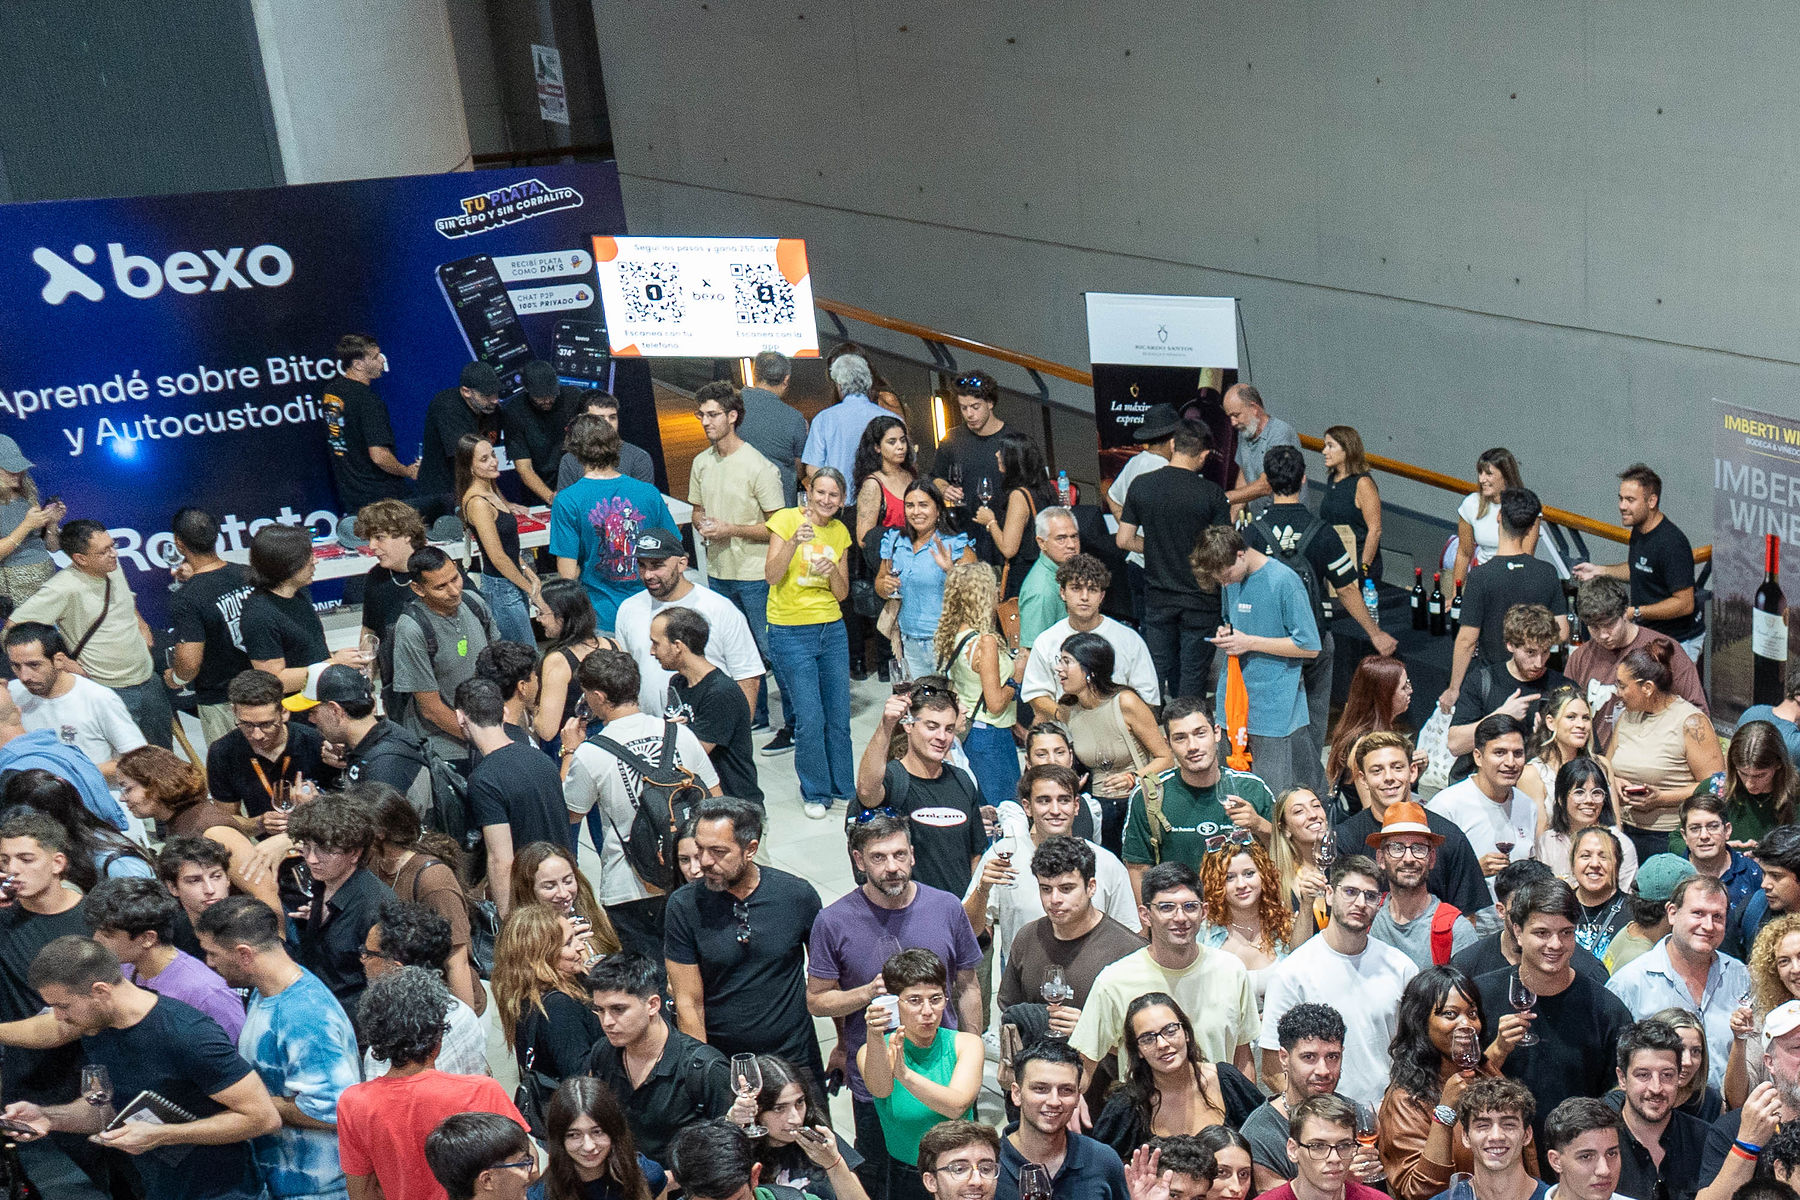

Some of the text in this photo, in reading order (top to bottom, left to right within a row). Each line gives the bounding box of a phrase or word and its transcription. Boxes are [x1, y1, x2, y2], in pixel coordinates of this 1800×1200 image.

[463, 181, 544, 214] TU PLATA,
[437, 189, 573, 231] SIN CEPO Y SIN CORRALITO
[538, 257, 563, 267] PLATA
[107, 243, 294, 299] bexo
[512, 266, 538, 276] COMO
[517, 292, 554, 302] CHAT P2P
[691, 291, 725, 301] bexo
[539, 298, 574, 308] PRIVADO
[156, 364, 260, 400] sobre
[1111, 400, 1152, 412] La máxi
[1116, 414, 1145, 426] expresi
[1724, 414, 1780, 441] IMBERTI
[63, 426, 86, 457] y
